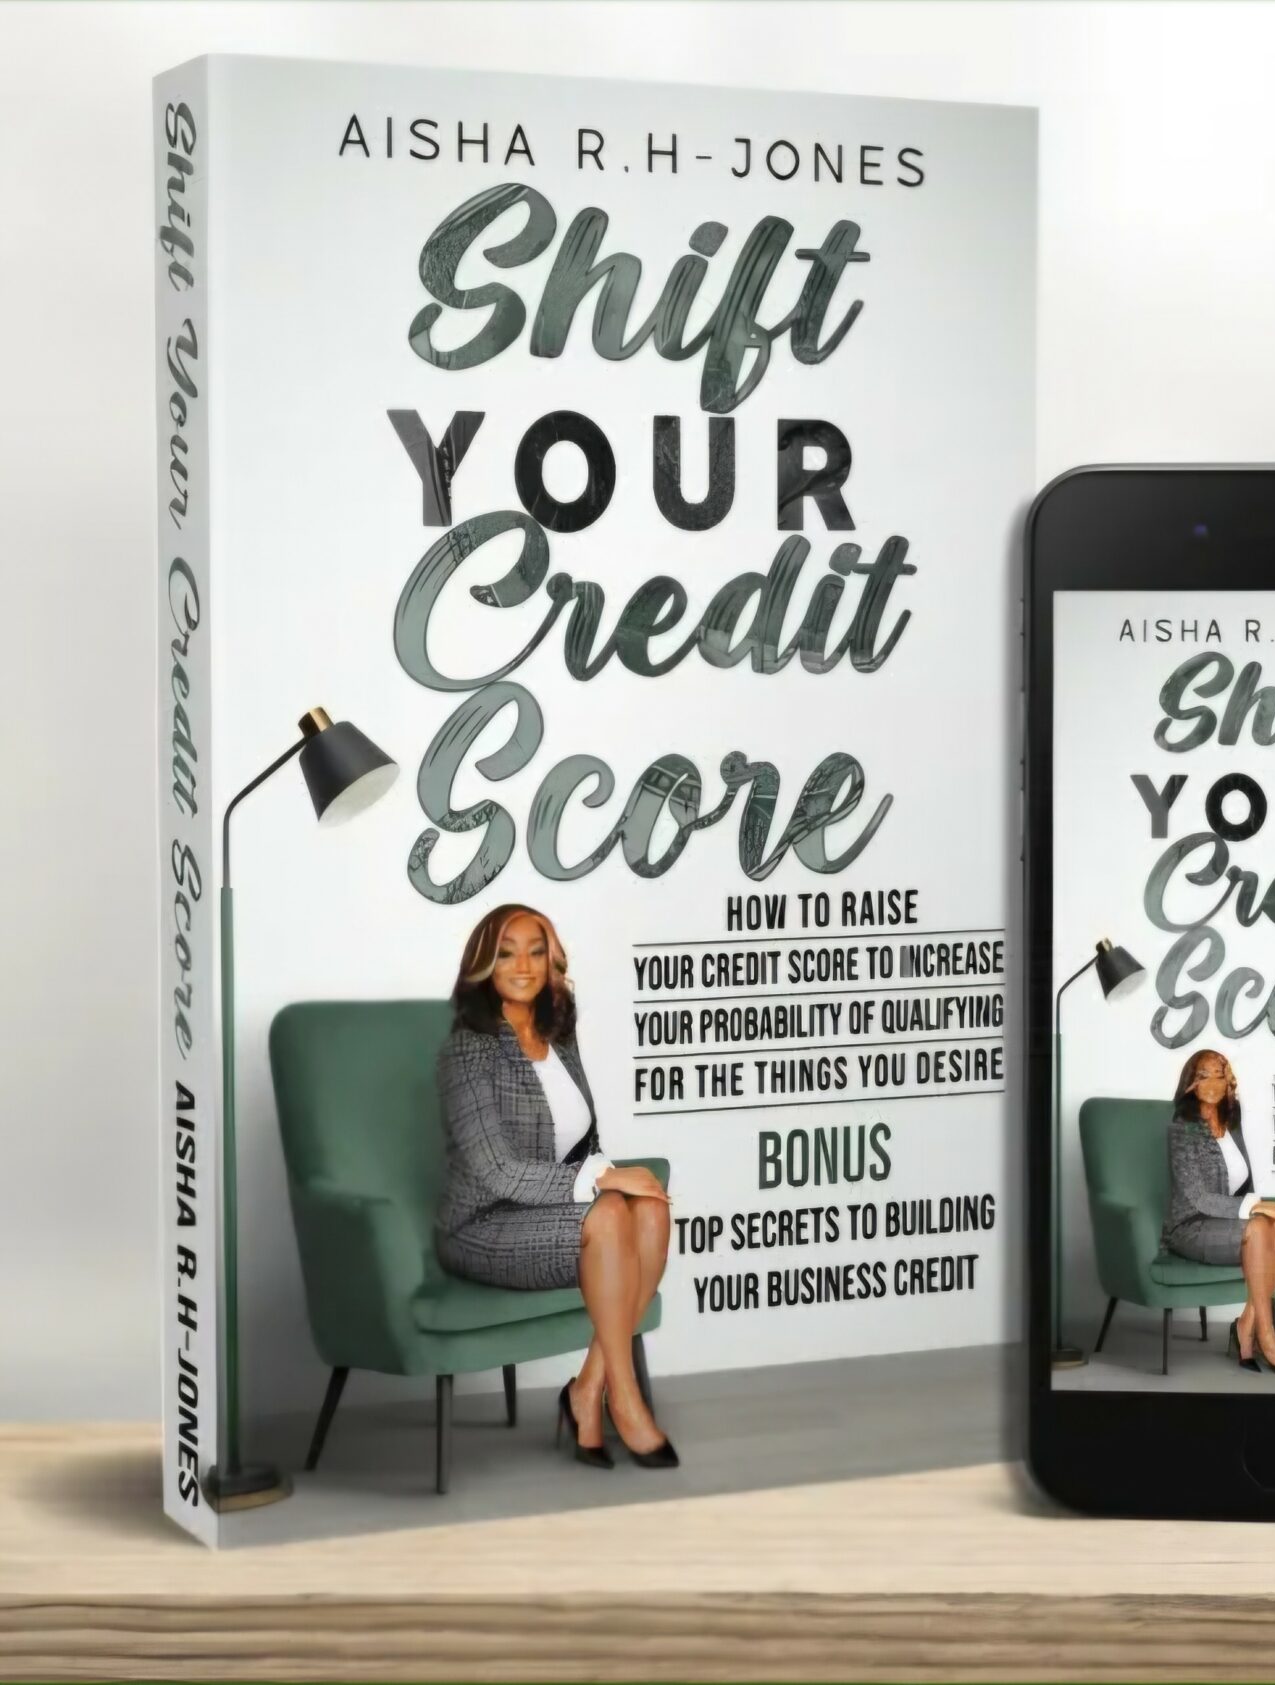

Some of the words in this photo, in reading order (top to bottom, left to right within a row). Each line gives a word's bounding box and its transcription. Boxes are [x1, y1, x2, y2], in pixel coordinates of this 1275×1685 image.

[160, 101, 197, 292] Shift
[338, 114, 536, 167] AISHA
[577, 129, 927, 189] R.H-JONES
[408, 182, 871, 414] Shift
[168, 317, 199, 531] Your
[386, 409, 856, 534] YOUR
[393, 510, 917, 693] Credit
[1119, 619, 1222, 643] AISHA
[168, 556, 201, 819] Credit
[407, 681, 894, 903] Score
[171, 835, 202, 1061] Score
[727, 894, 786, 931] HOW
[798, 892, 829, 928] TO
[841, 889, 919, 927] RAISE
[634, 954, 693, 991] YOUR
[701, 950, 781, 987] CREDIT
[787, 947, 859, 983] SCORE
[866, 945, 893, 979] TO
[899, 940, 1004, 978] INCREASE
[634, 1010, 693, 1047] YOUR
[700, 1002, 842, 1043] PROBABILITY
[849, 1000, 875, 1034] OF
[881, 993, 1004, 1034] QUALIFYING
[634, 1066, 684, 1102] FOR
[694, 1062, 744, 1097] THE
[755, 1056, 848, 1094] THINGS
[858, 1052, 906, 1088] YOU
[916, 1047, 1004, 1084] DESIRE
[175, 1078, 197, 1229] AISHA
[758, 1122, 892, 1190] BONUS
[674, 1215, 724, 1255] TOP
[730, 1204, 840, 1251] SECRETS
[847, 1203, 877, 1240] TO
[884, 1194, 996, 1238] BUILDING
[693, 1272, 759, 1314] YOUR
[767, 1261, 887, 1307] BUSINESS
[893, 1254, 979, 1296] CREDIT
